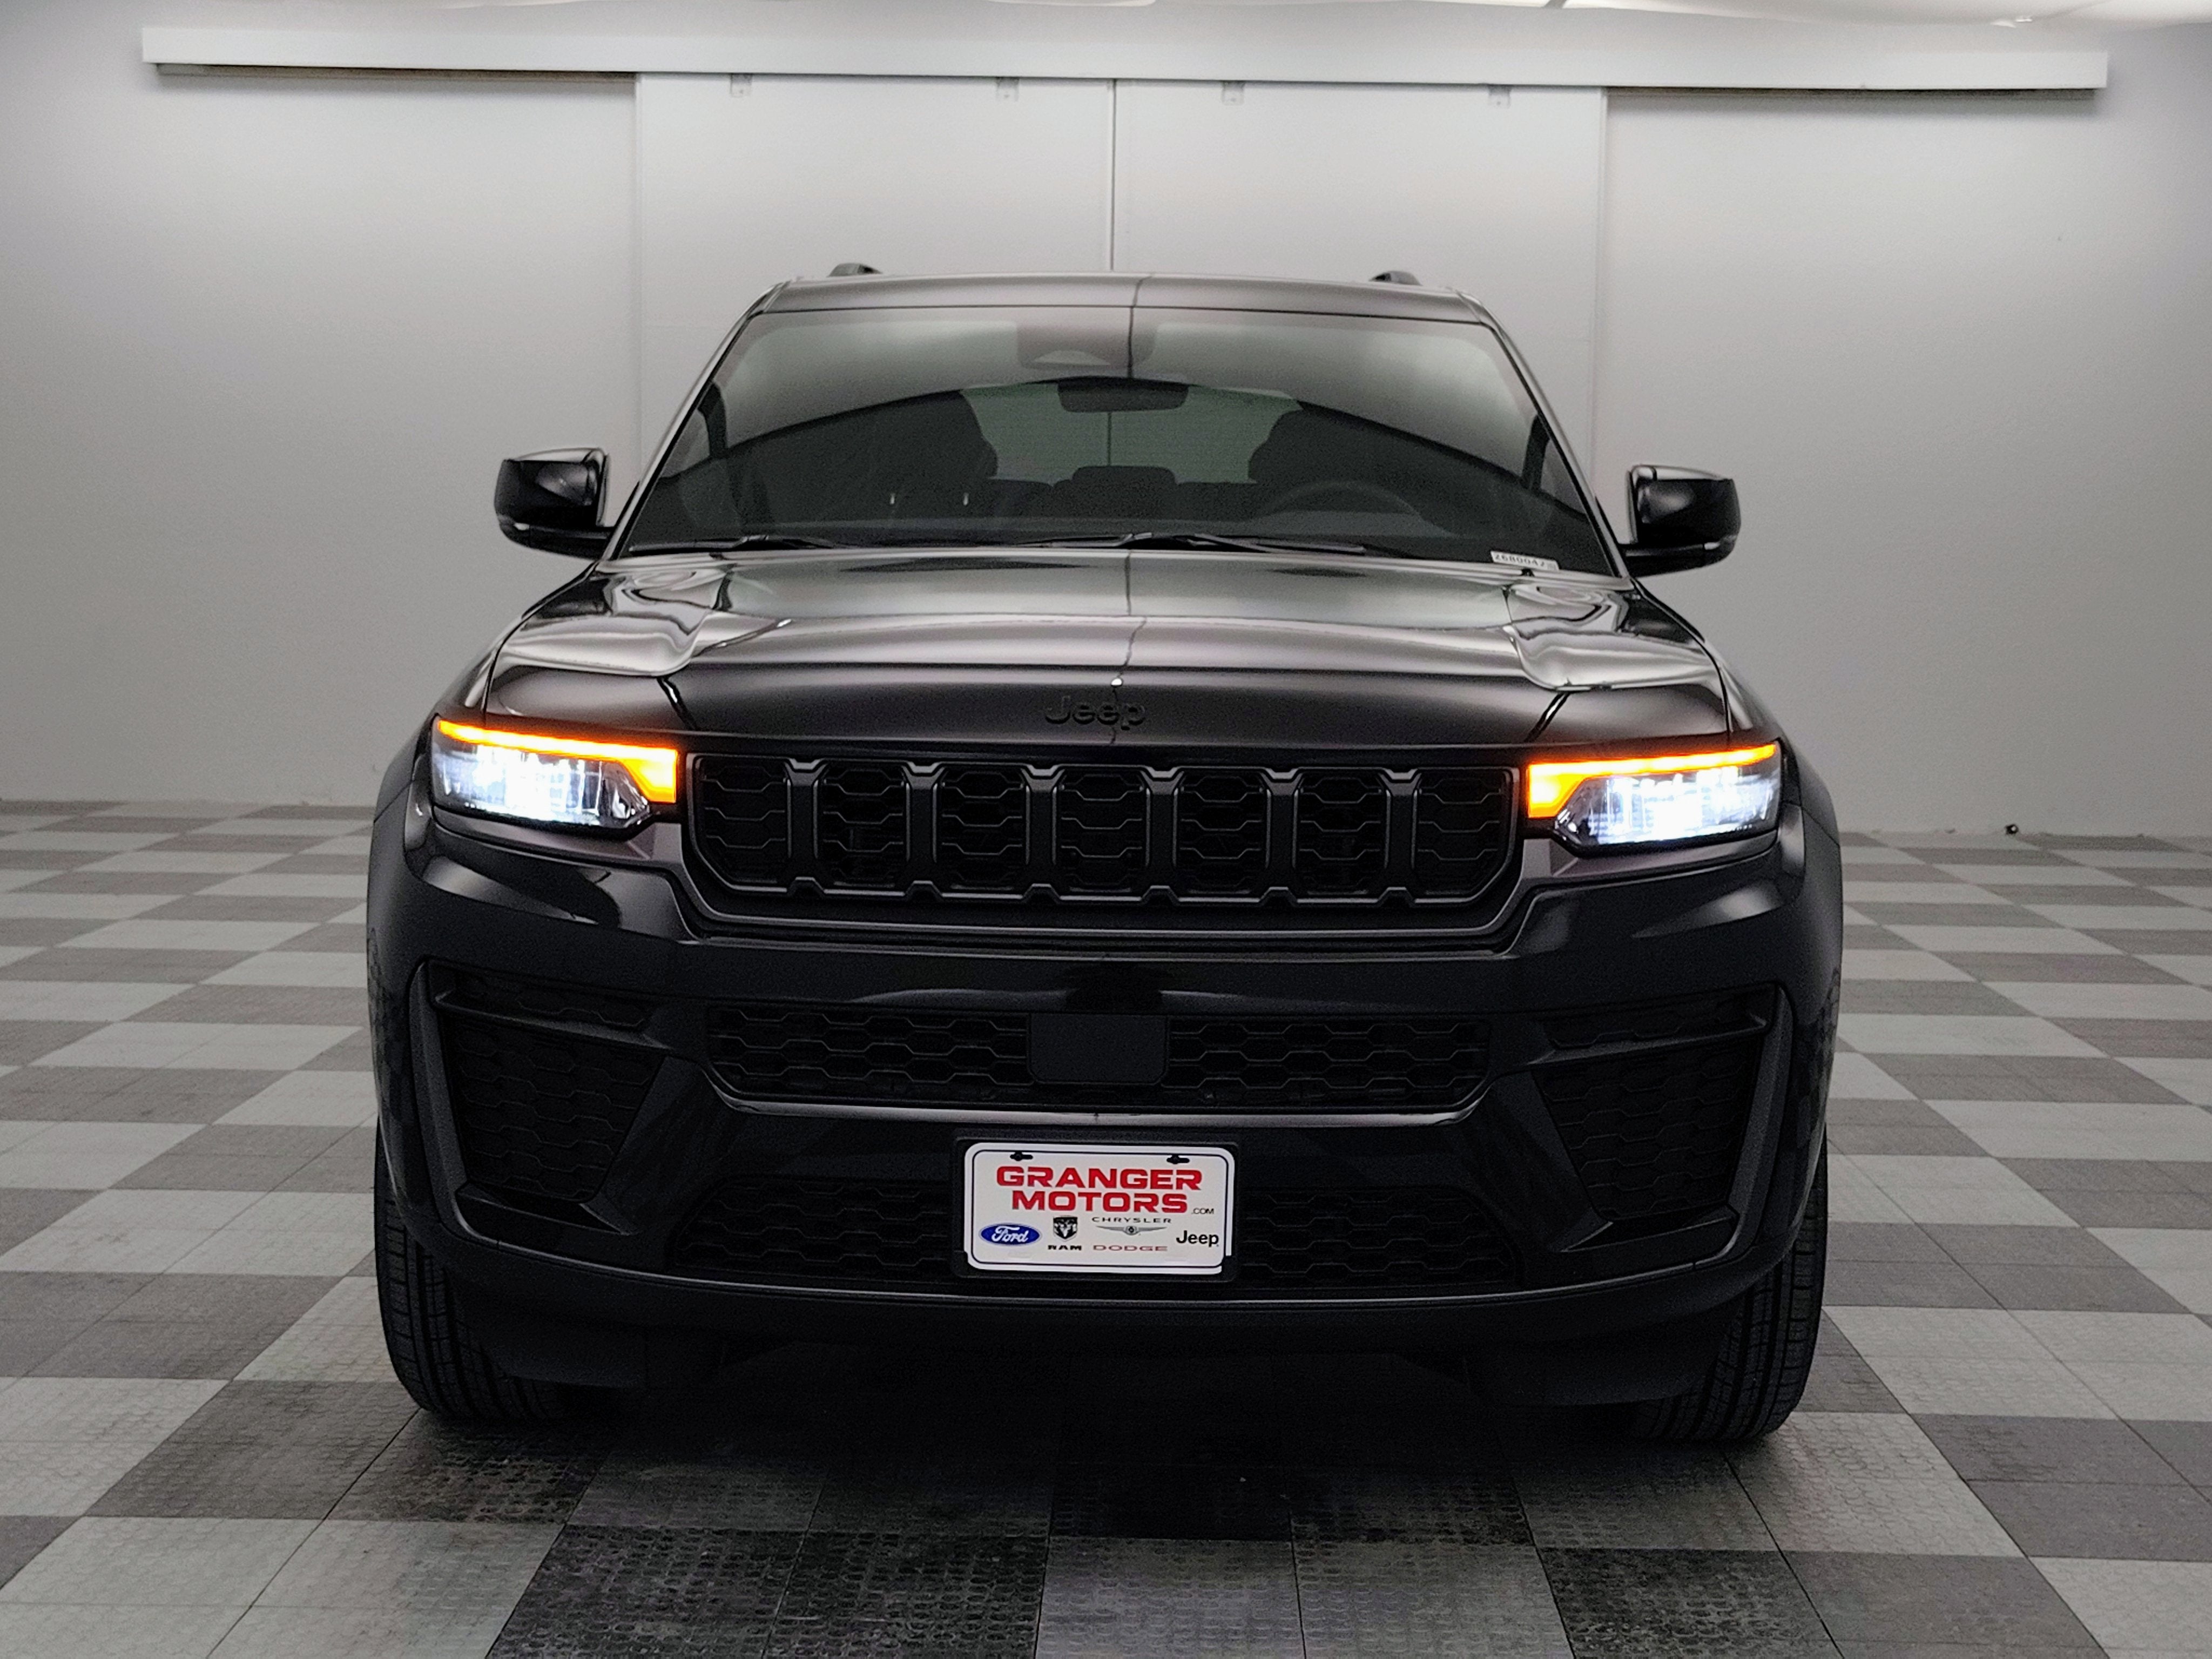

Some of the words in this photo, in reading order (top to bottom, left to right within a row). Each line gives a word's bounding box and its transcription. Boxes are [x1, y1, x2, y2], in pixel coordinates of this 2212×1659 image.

[1045, 695, 1146, 731] Jeep
[996, 1166, 1202, 1190] GRANGER
[1012, 1190, 1188, 1213] MOTORS
[991, 1225, 1029, 1243] Ford
[1176, 1230, 1219, 1247] Jeep
